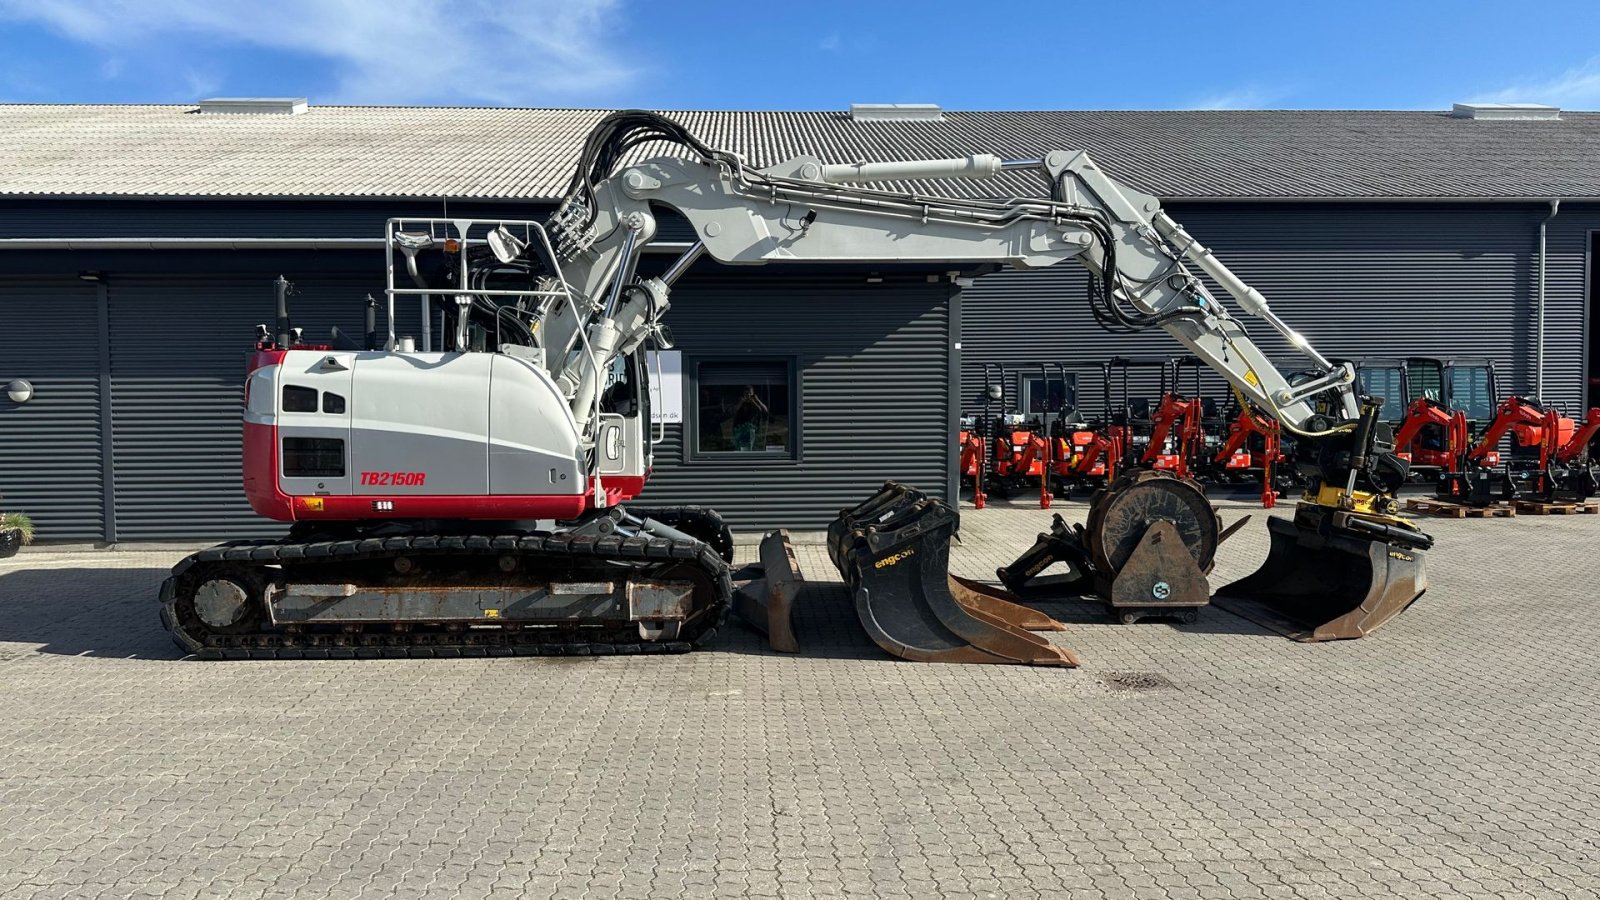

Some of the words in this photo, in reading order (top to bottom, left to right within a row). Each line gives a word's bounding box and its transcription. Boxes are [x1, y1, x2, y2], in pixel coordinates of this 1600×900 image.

[361, 472, 426, 486] TB2150R
[875, 549, 915, 569] engcon
[1025, 555, 1054, 577] engcon
